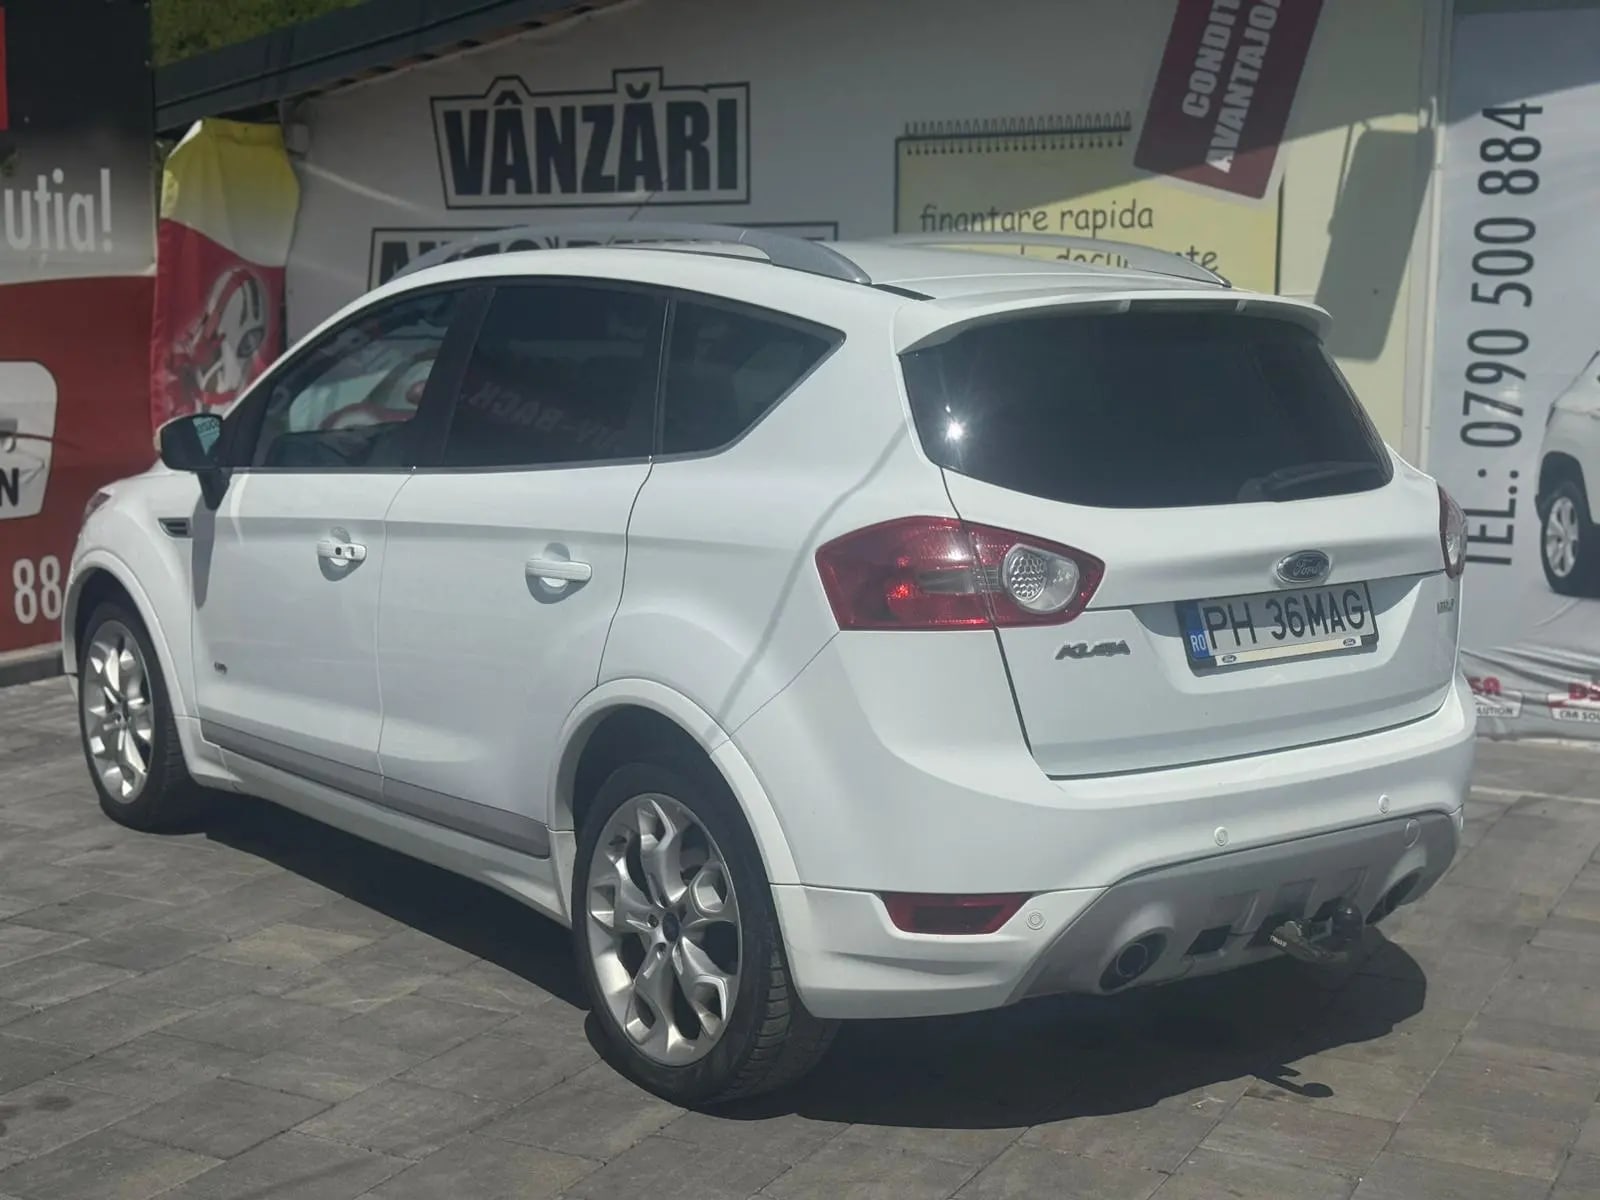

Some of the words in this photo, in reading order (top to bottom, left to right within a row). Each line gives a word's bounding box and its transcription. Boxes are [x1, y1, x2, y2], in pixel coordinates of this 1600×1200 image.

[443, 82, 737, 195] VÂNZĂRI
[1477, 103, 1543, 195] 884
[1060, 198, 1154, 239] rapida
[1471, 217, 1536, 308] 500
[1460, 329, 1529, 447] 0790
[1190, 633, 1206, 653] RO
[1202, 603, 1257, 649] PH
[1265, 589, 1365, 640] 36MAG
